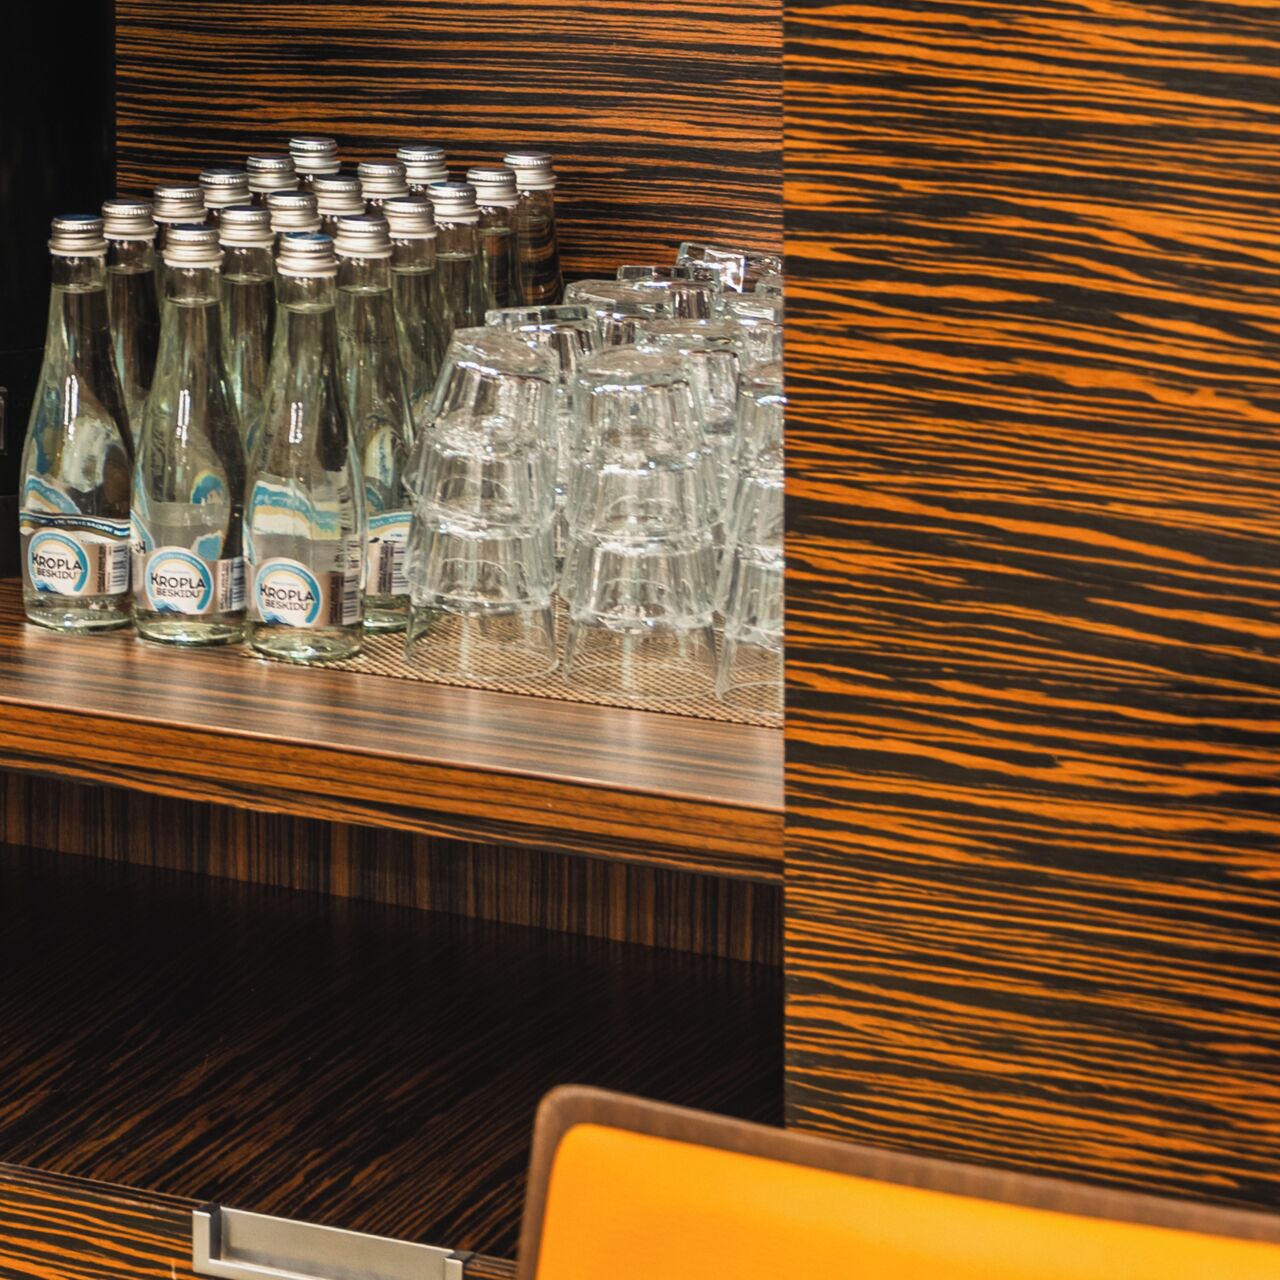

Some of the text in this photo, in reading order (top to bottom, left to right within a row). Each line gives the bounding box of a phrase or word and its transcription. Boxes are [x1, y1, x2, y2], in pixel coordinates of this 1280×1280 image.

[31, 552, 83, 571] KROPLA
[150, 573, 207, 590] KROPLA
[260, 583, 315, 602] KROPLA
